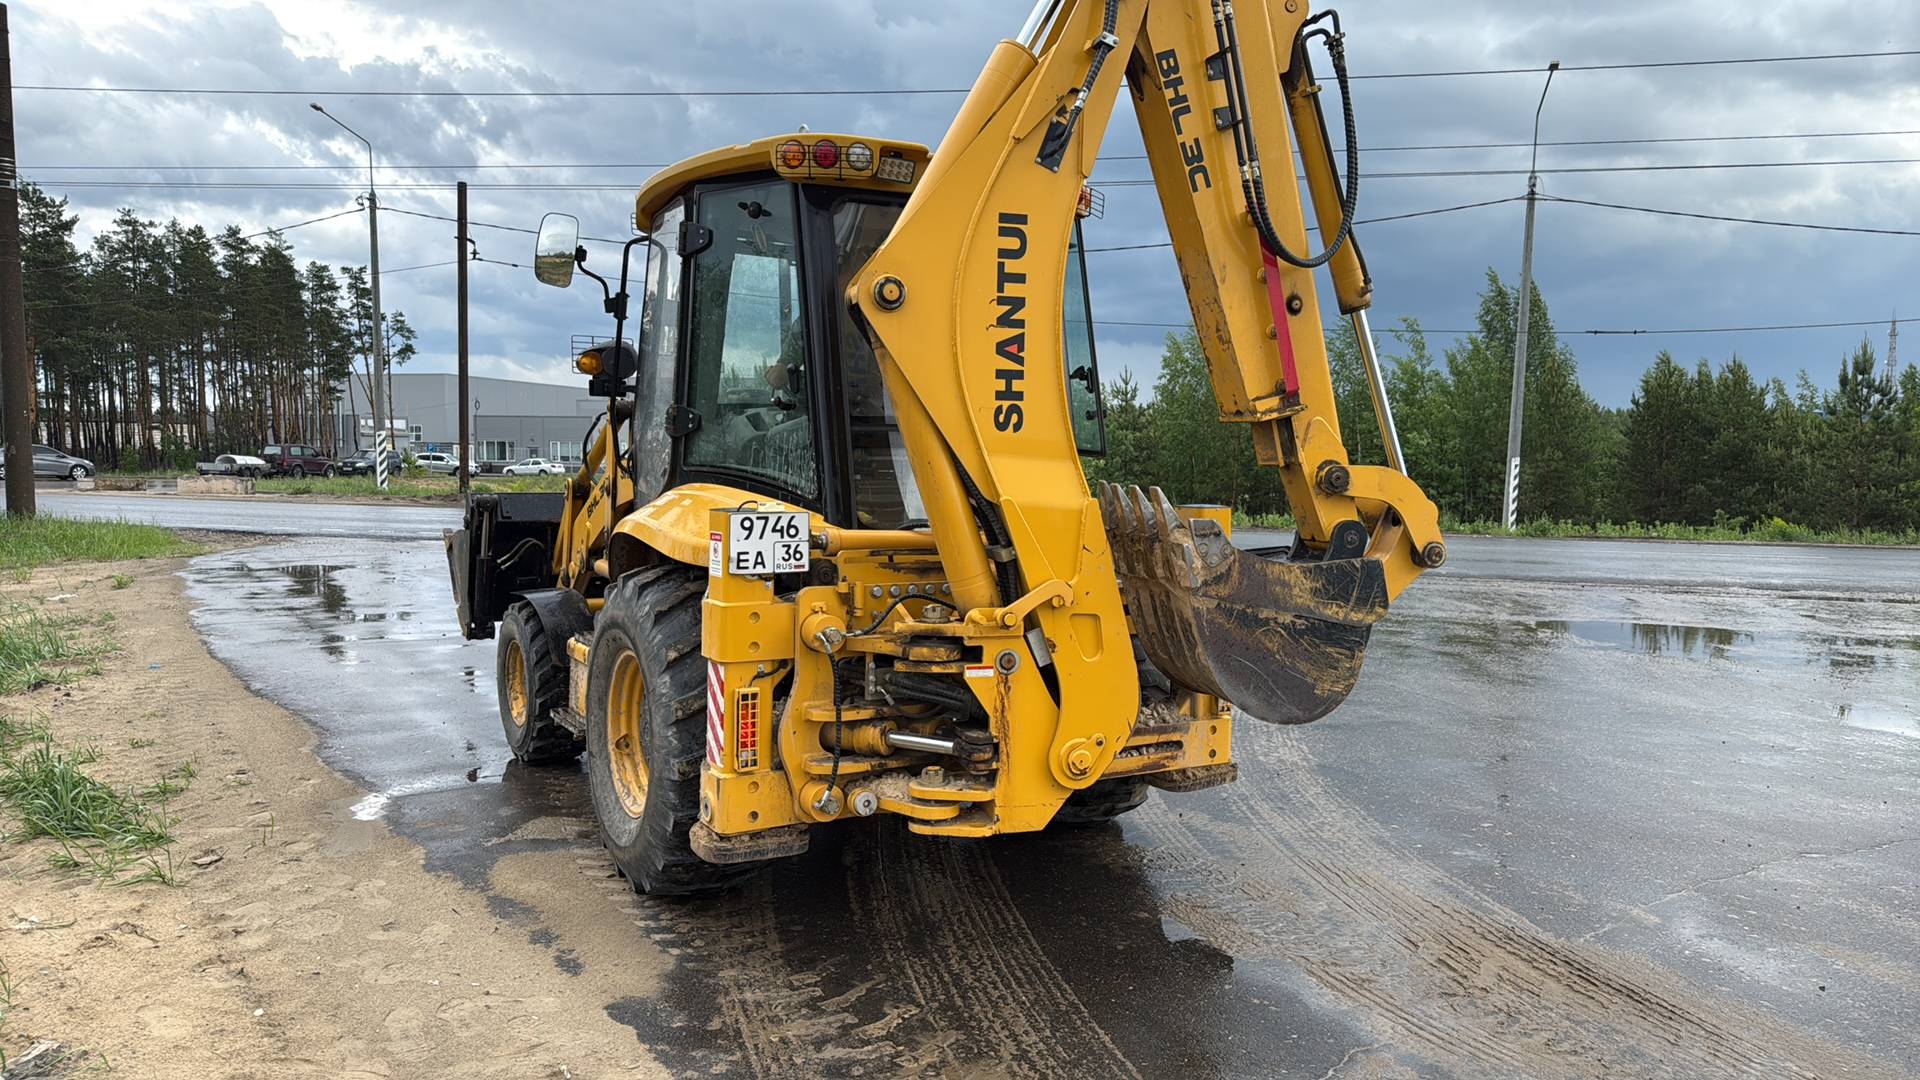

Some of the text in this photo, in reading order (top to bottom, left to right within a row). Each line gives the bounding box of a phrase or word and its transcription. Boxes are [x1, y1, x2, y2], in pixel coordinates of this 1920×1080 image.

[1155, 48, 1212, 193] BHL 3C
[993, 212, 1028, 433] SHANTUI
[740, 515, 799, 540] 9746
[736, 551, 766, 570] EA
[781, 544, 803, 562] 36
